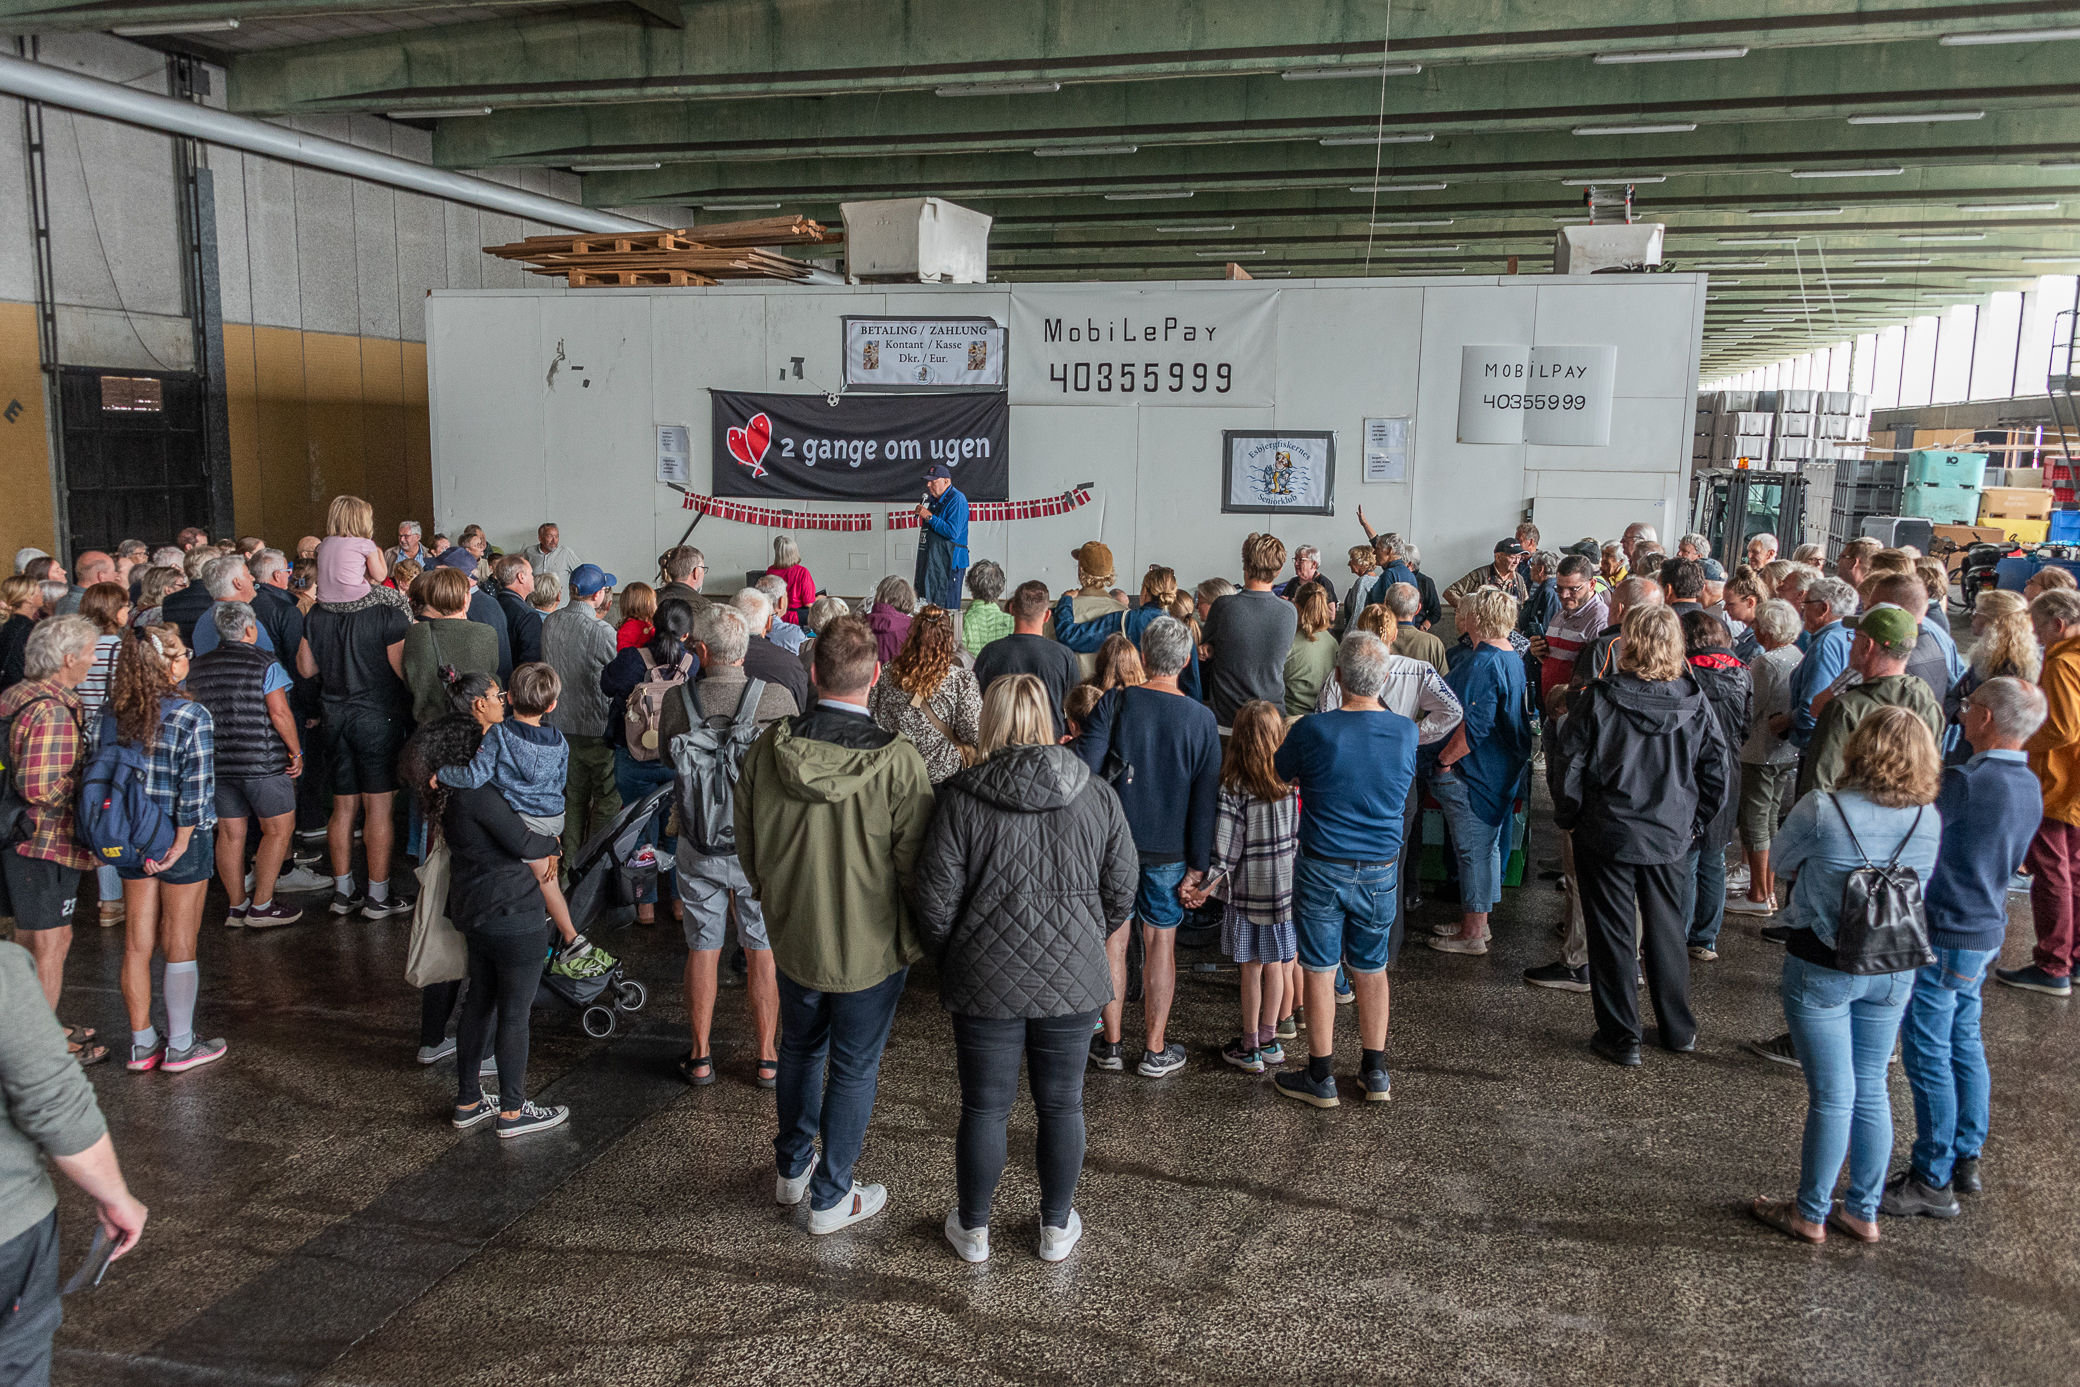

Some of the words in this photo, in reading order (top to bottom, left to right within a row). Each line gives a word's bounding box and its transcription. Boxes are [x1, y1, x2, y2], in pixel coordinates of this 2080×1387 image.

[860, 326, 918, 336] BETALING
[930, 326, 988, 336] ZAHLUNG
[885, 340, 924, 350] Kontant
[935, 340, 962, 350] Kasse
[899, 353, 920, 363] Dkr.
[929, 353, 949, 363] Eur.
[1049, 362, 1232, 393] 40355999
[1483, 393, 1586, 411] 40355999
[780, 437, 795, 458] 2
[803, 438, 878, 468] gange
[884, 438, 922, 460] om
[930, 437, 991, 468] ugen
[1248, 439, 1311, 461] Esbjergfiskernes
[1257, 493, 1298, 505] Seniorklub
